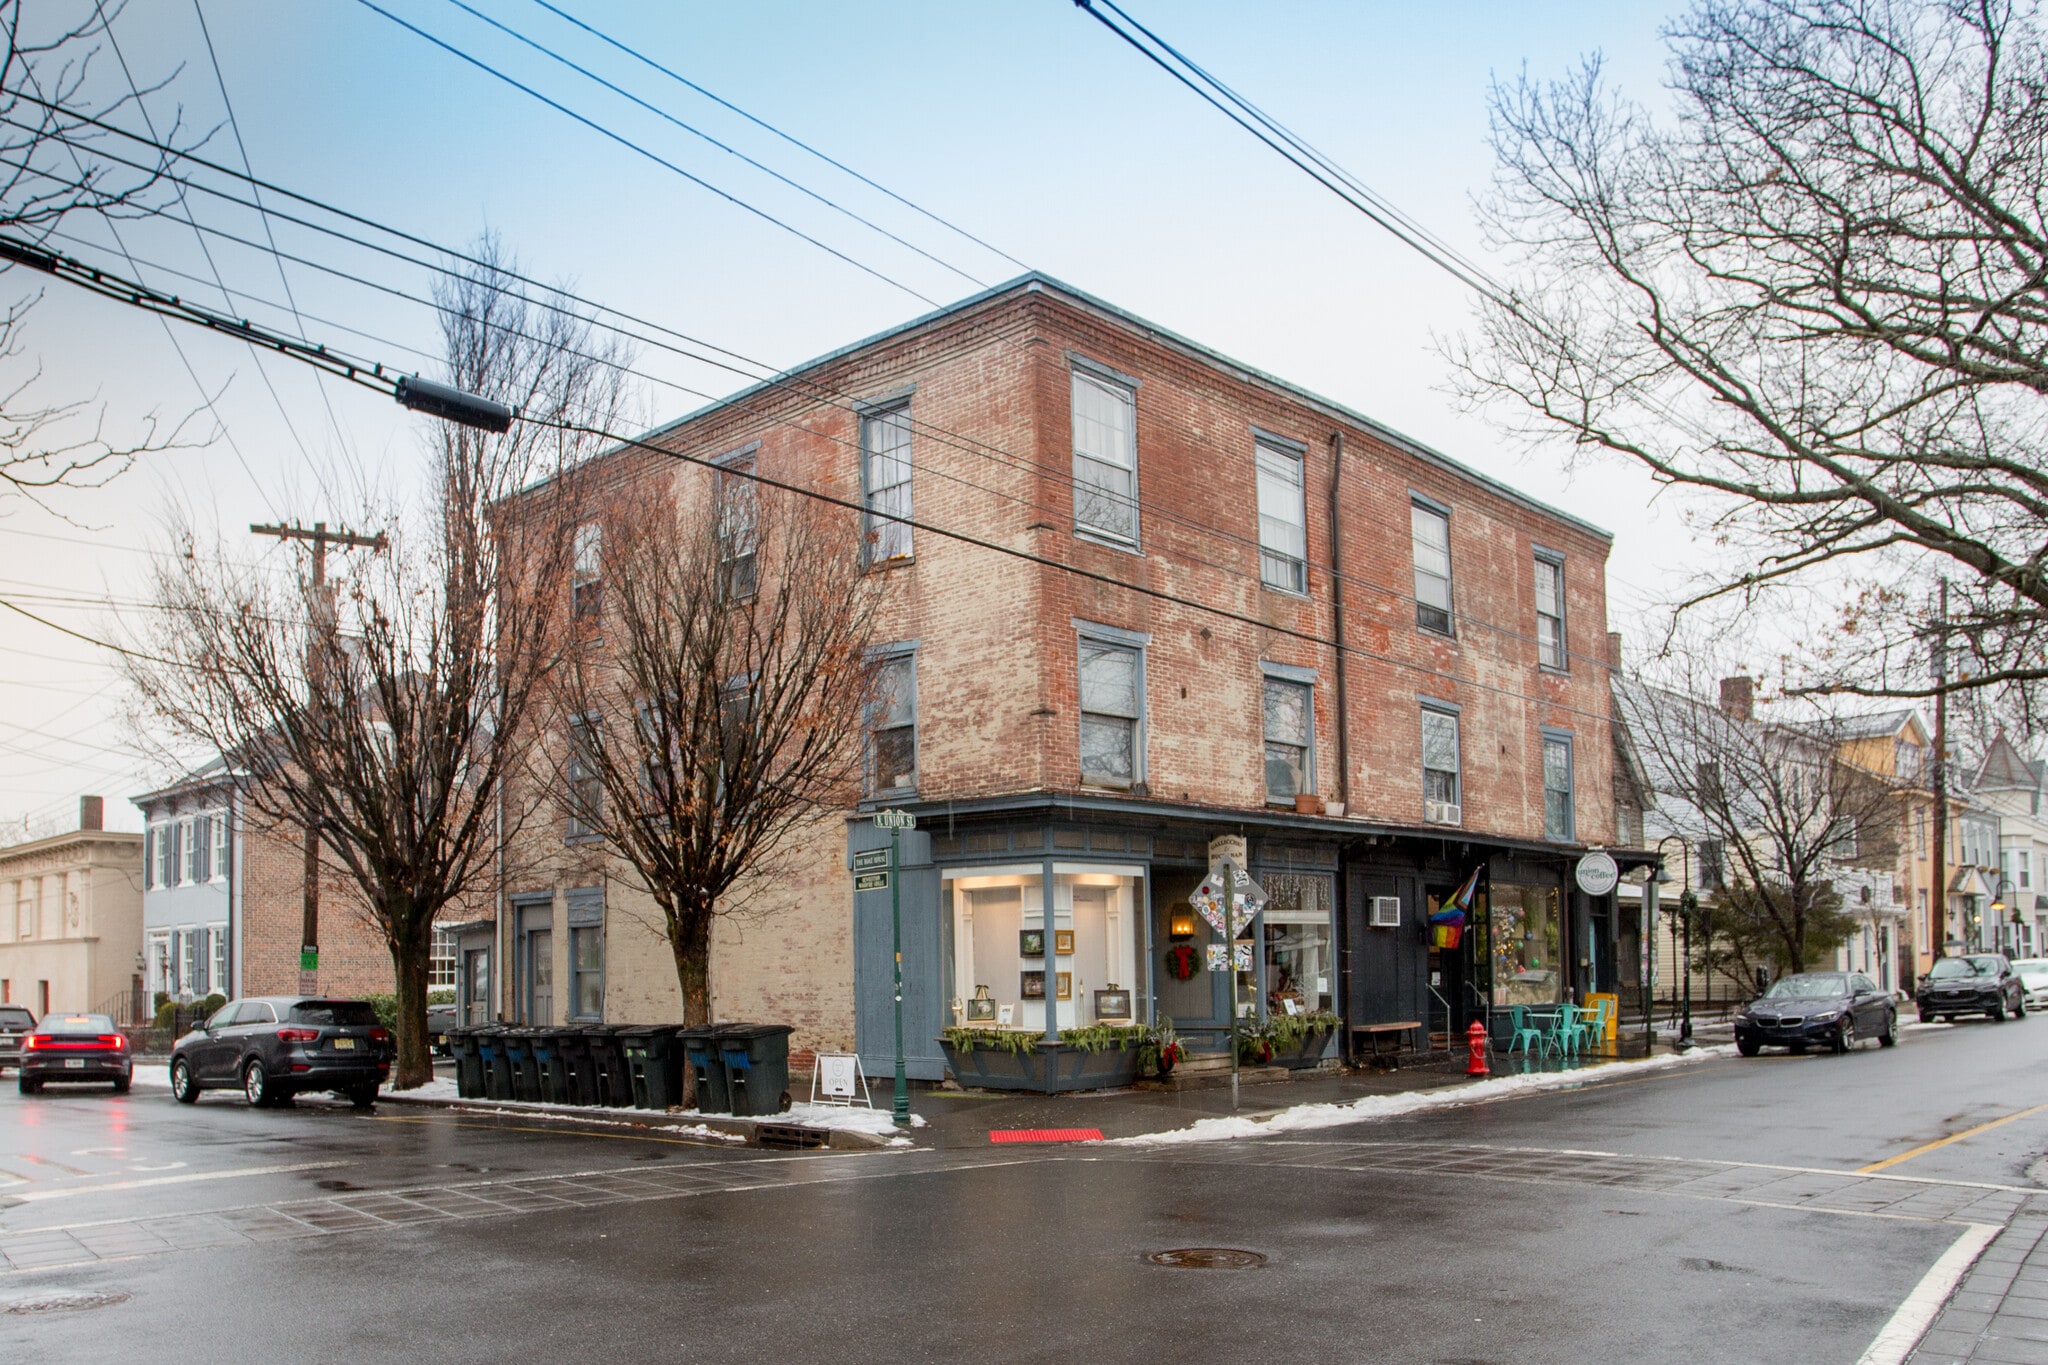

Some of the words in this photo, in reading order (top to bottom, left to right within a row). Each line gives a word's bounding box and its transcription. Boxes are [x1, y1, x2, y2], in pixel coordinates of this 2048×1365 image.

[884, 815, 905, 826] UNION
[1578, 866, 1600, 876] union
[829, 1078, 848, 1088] OPEN
